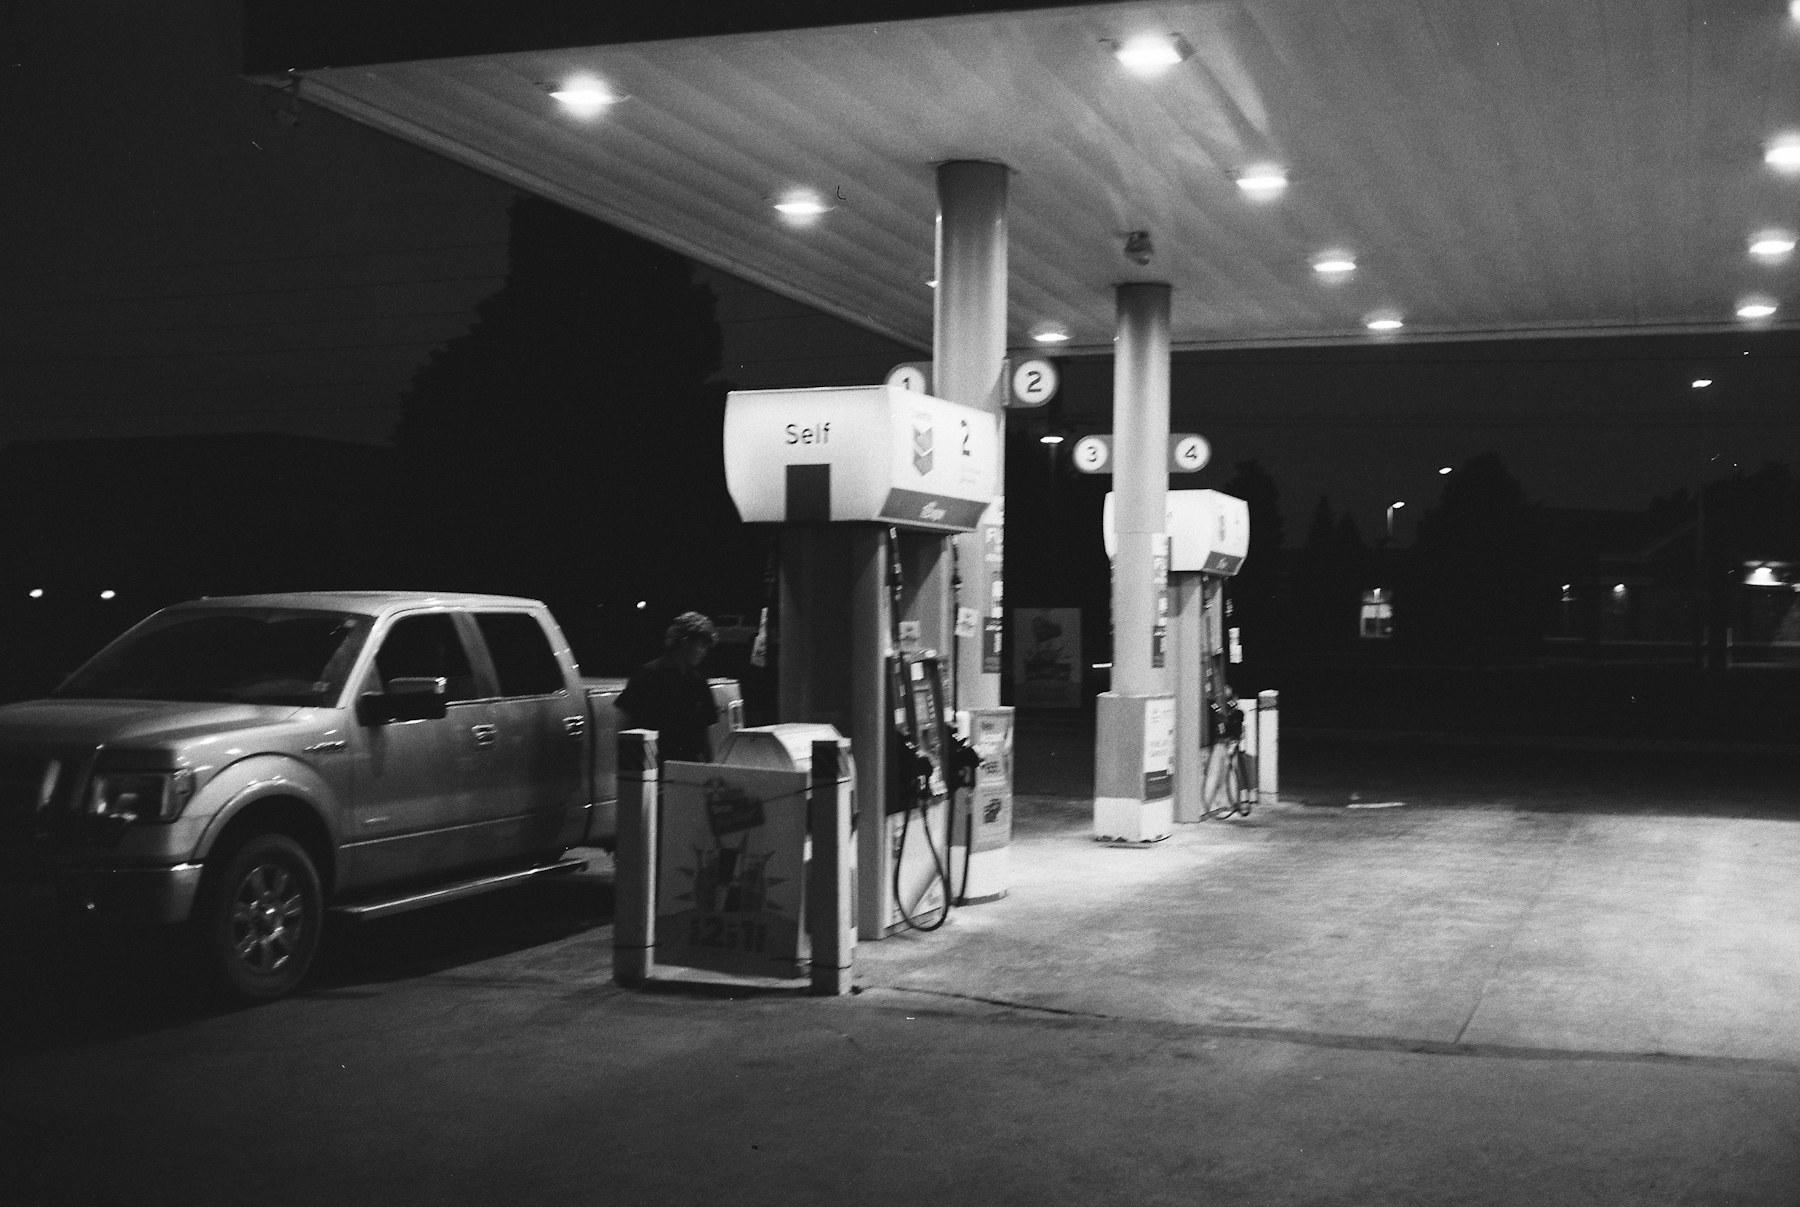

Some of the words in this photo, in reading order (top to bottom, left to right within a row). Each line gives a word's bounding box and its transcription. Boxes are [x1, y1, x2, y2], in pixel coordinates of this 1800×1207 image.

[1027, 370, 1042, 393] 2
[786, 422, 831, 445] Self
[960, 420, 971, 456] 2
[1086, 445, 1097, 463] 3
[1184, 445, 1198, 463] 4
